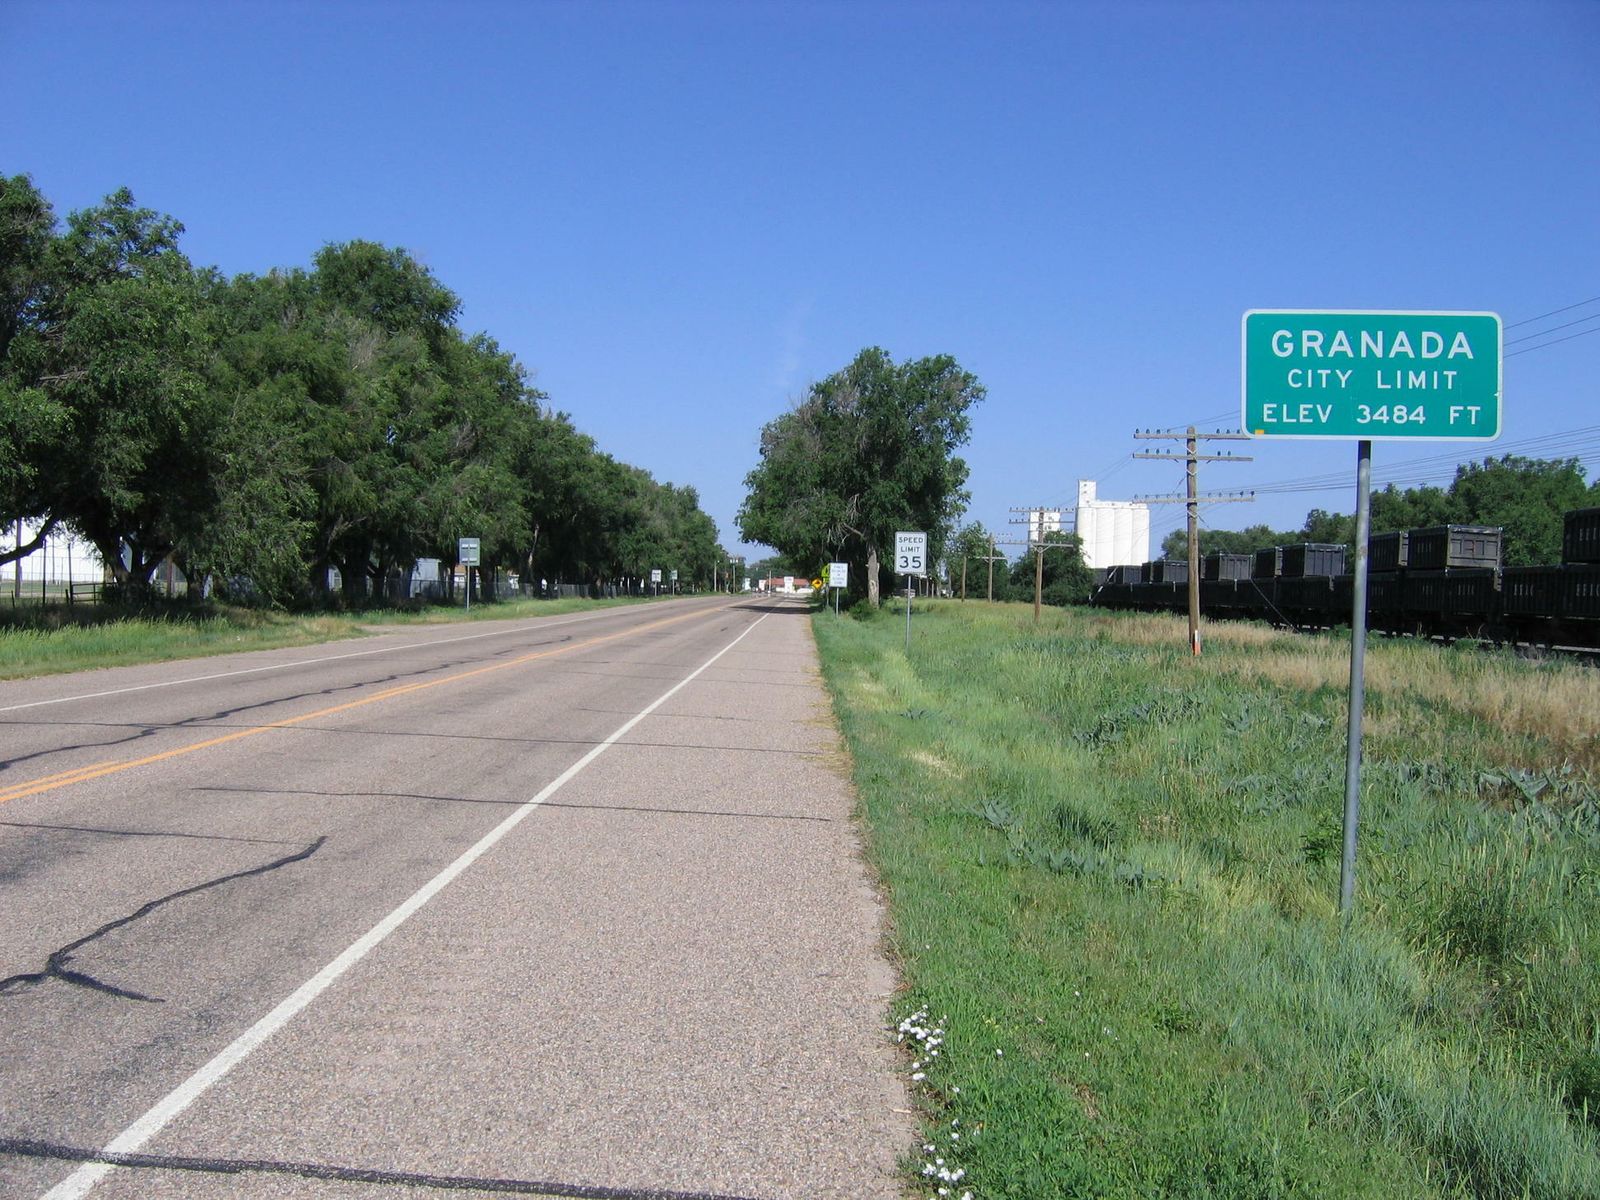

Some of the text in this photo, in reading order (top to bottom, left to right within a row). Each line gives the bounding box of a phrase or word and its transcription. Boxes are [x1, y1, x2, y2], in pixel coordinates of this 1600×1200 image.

[1272, 330, 1474, 359] GRANADA
[1287, 368, 1458, 390] CITY LIMIT
[1263, 403, 1481, 425] ELEV 3484 FT
[899, 556, 922, 568] 35
